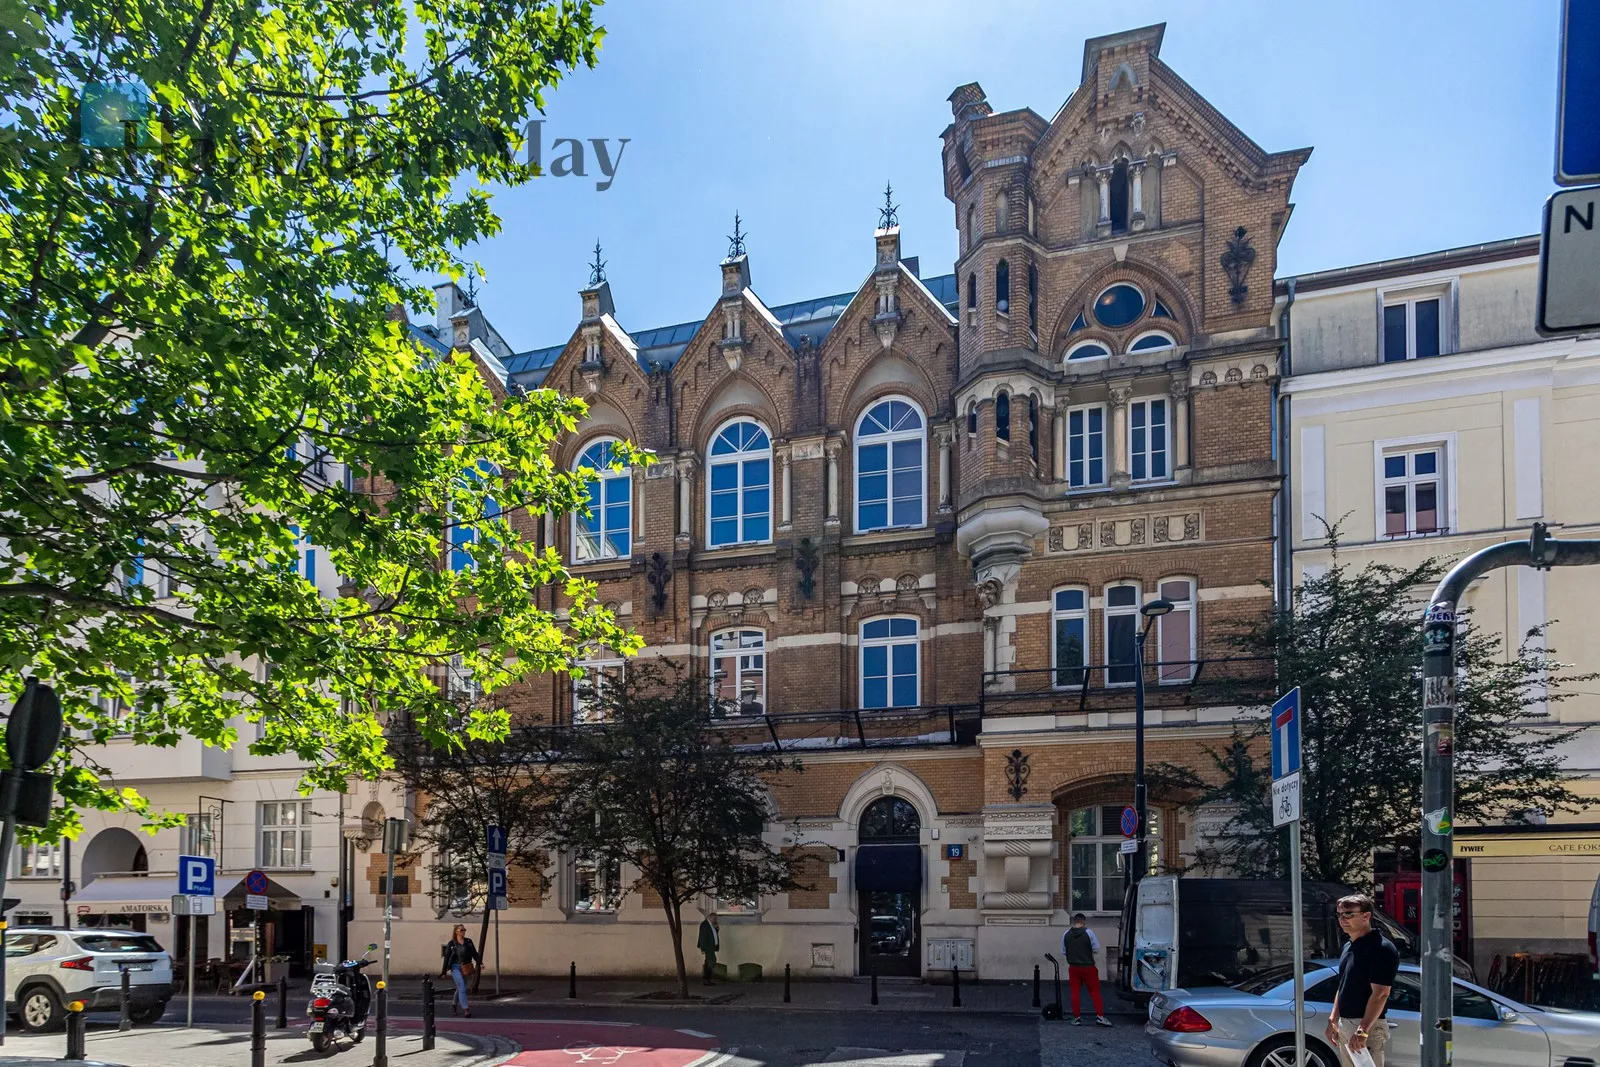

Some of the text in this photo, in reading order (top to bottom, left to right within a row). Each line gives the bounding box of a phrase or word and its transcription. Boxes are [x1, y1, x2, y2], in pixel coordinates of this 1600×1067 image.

[1281, 780, 1298, 793] dotyczy
[951, 848, 960, 857] 19
[187, 861, 207, 890] P
[493, 873, 503, 894] P
